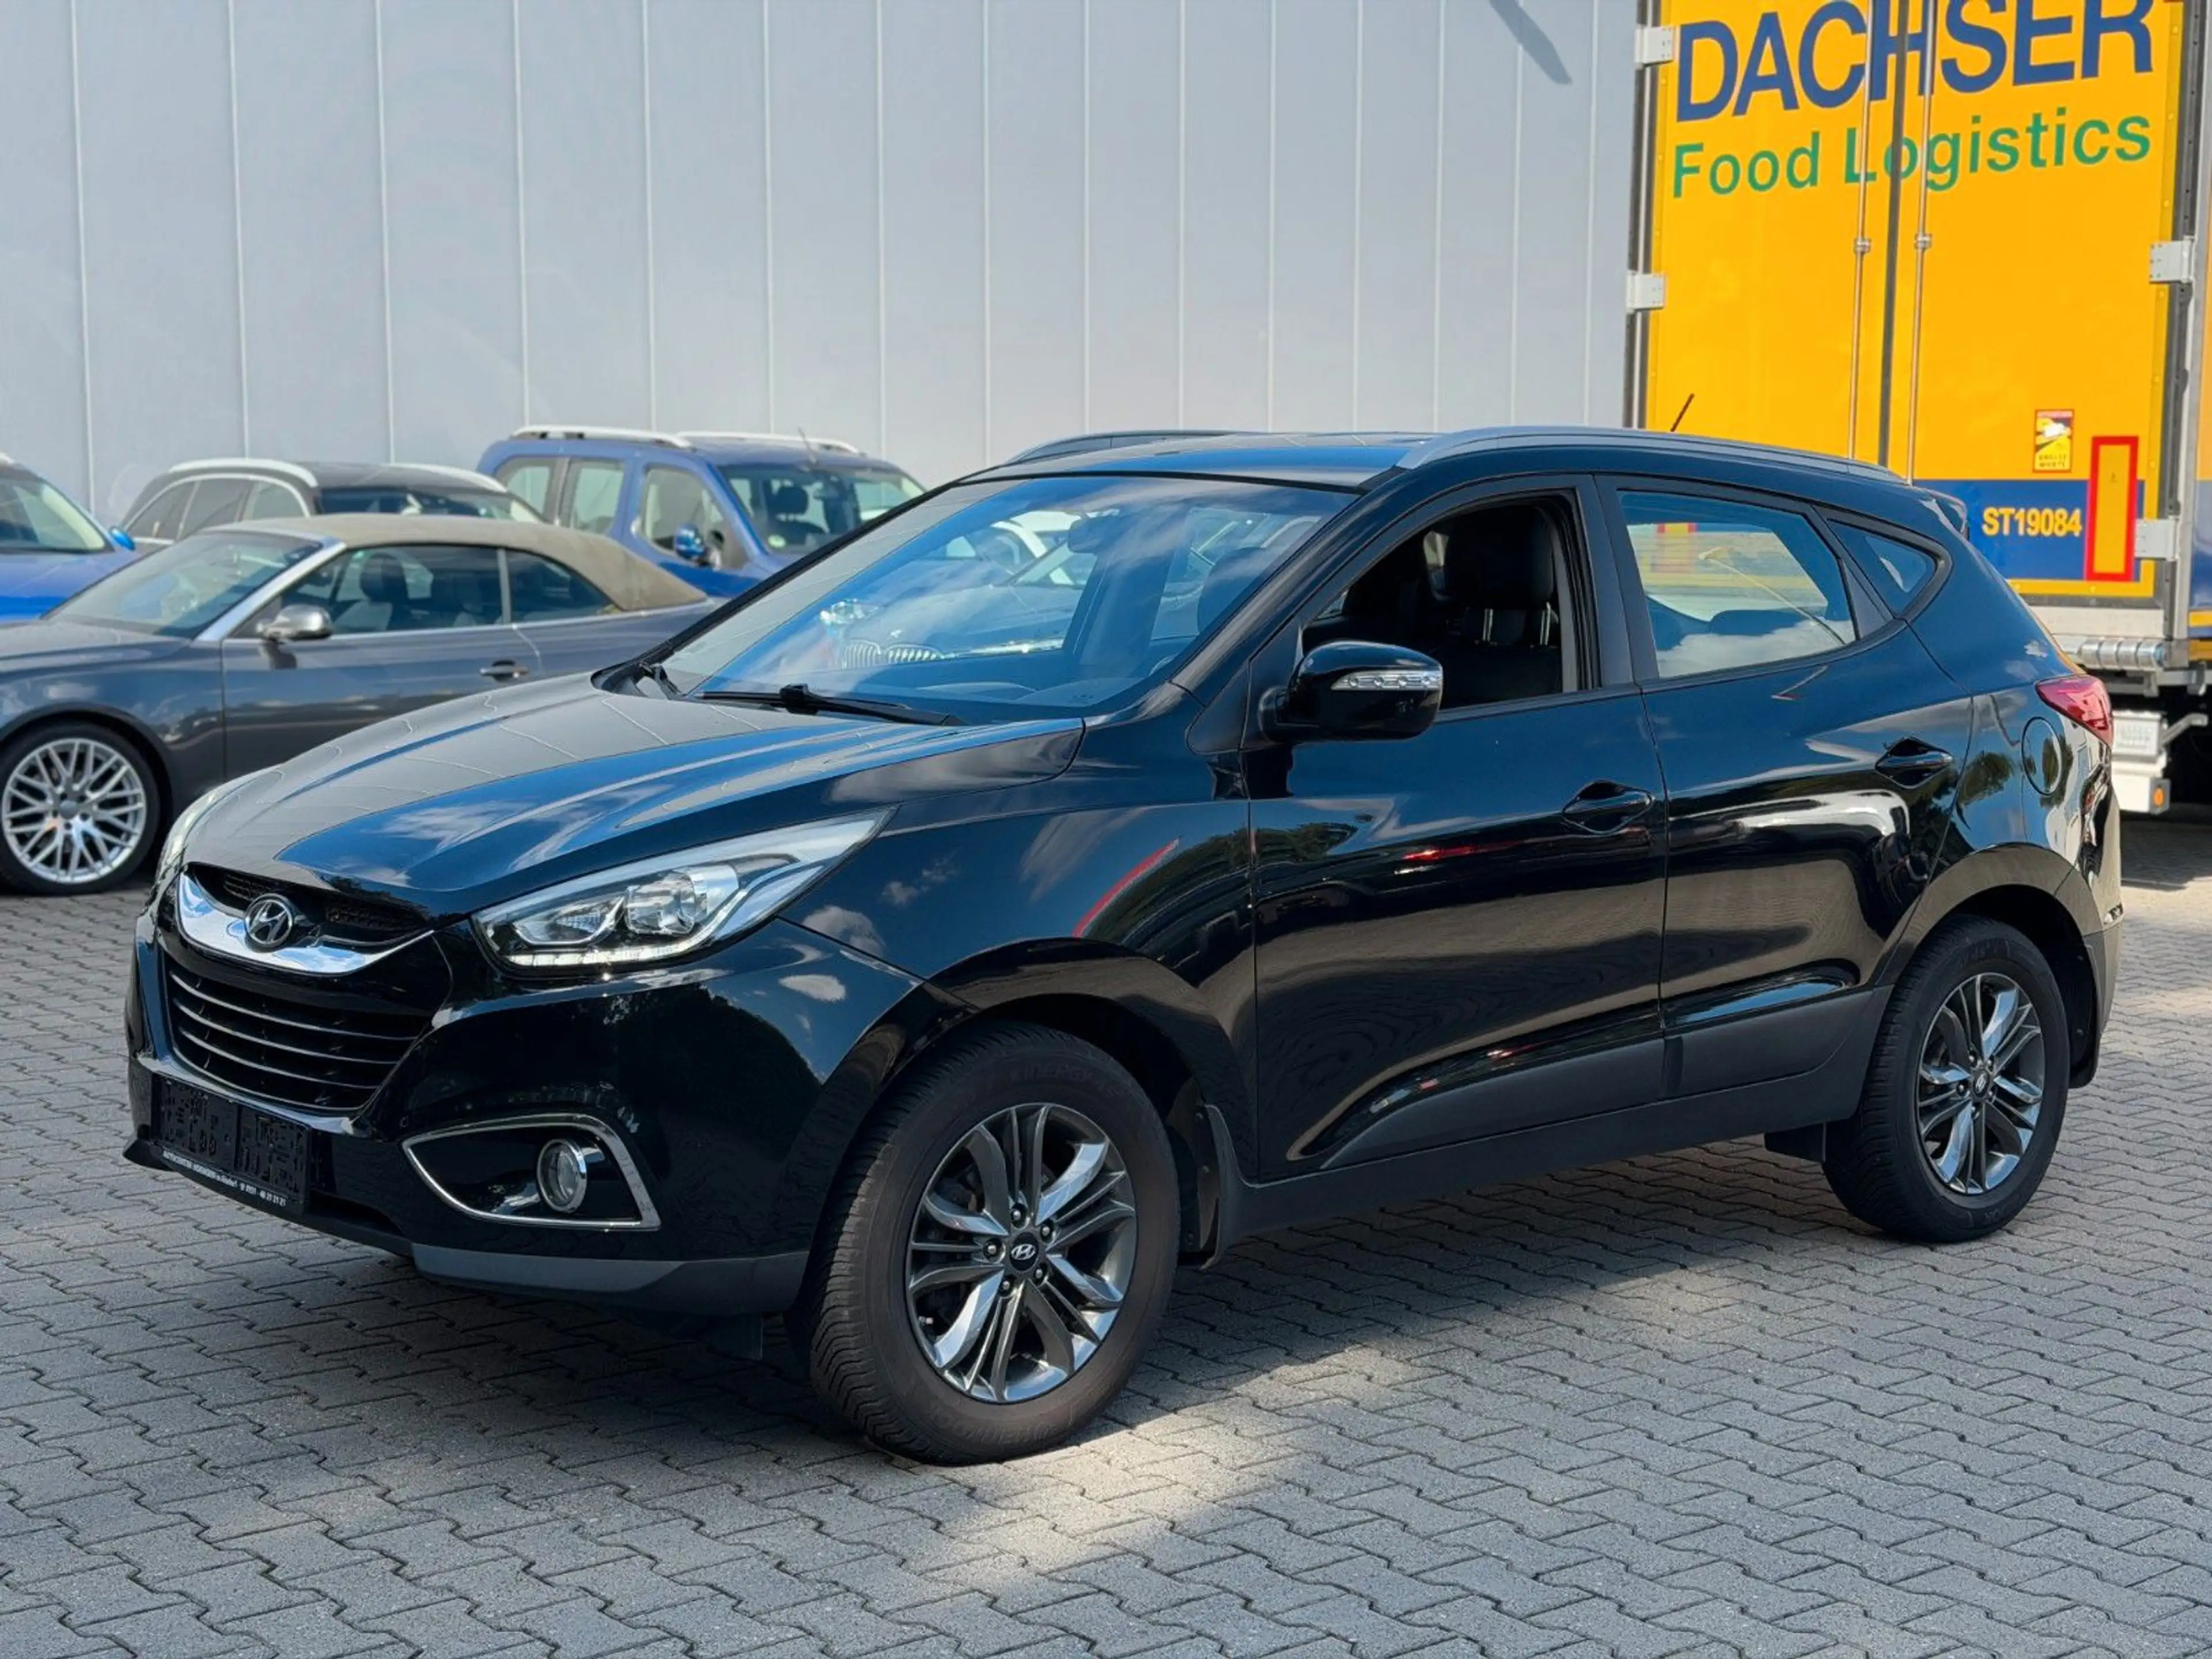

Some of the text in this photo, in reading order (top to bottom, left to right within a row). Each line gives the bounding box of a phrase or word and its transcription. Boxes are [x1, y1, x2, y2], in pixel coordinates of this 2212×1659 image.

[1677, 0, 2153, 121] DACHSER
[1673, 108, 2151, 197] Food Logistics
[1982, 506, 2082, 537] ST19084
